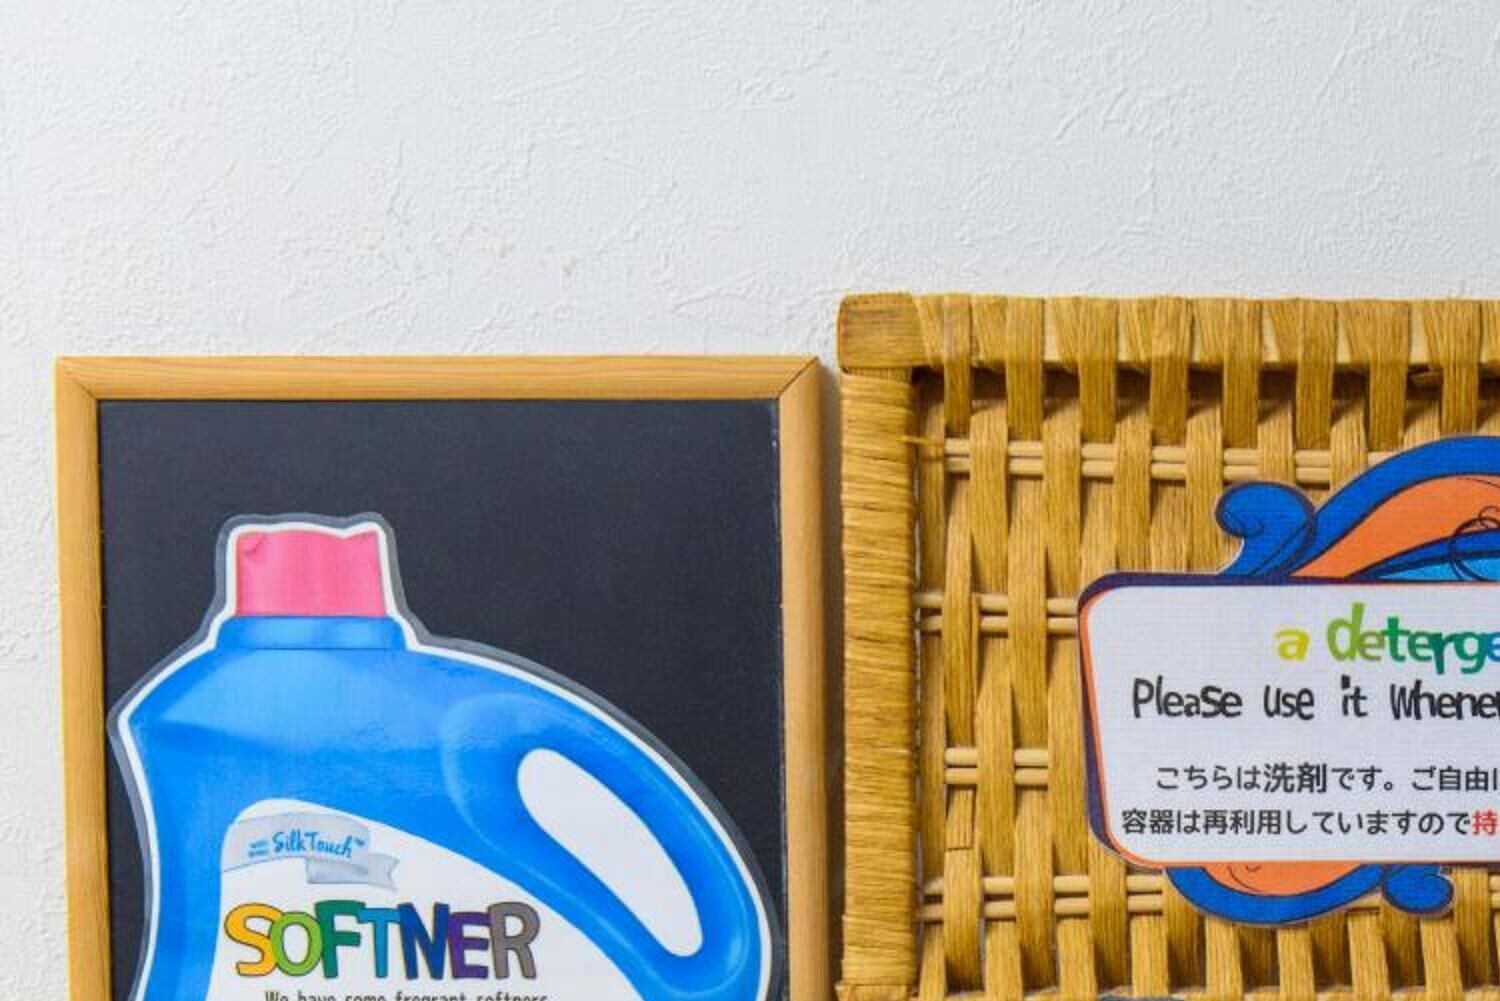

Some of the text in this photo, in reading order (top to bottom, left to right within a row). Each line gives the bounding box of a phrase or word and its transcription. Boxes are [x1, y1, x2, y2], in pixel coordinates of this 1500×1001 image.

[1274, 627, 1310, 662] a
[1132, 677, 1243, 720] Please
[1263, 684, 1315, 720] use
[1340, 675, 1368, 719] it
[223, 900, 541, 980] SOFTNER
